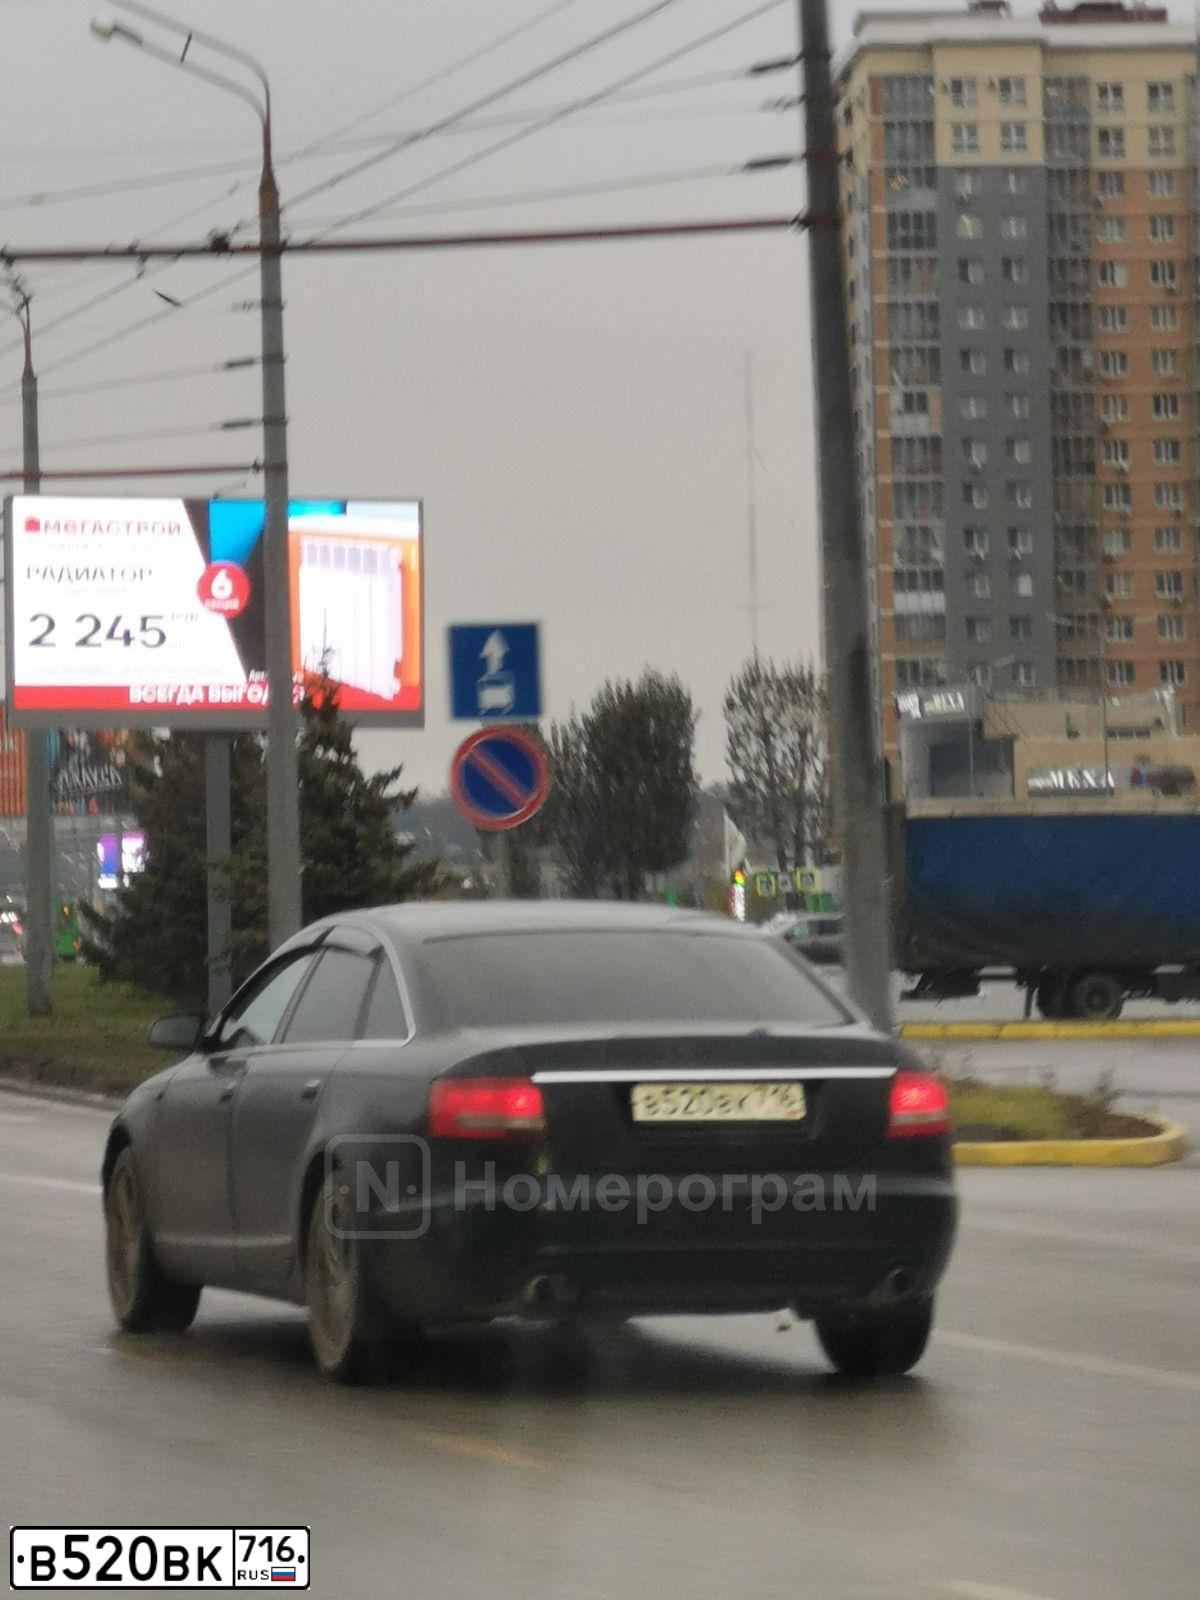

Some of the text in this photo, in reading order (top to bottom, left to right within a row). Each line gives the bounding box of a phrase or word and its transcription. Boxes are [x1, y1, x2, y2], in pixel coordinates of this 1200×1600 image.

[26, 565, 153, 583] РАДИАТОР
[210, 568, 233, 600] 6
[28, 613, 167, 649] 2 245
[129, 684, 204, 705] ВСЕГДА
